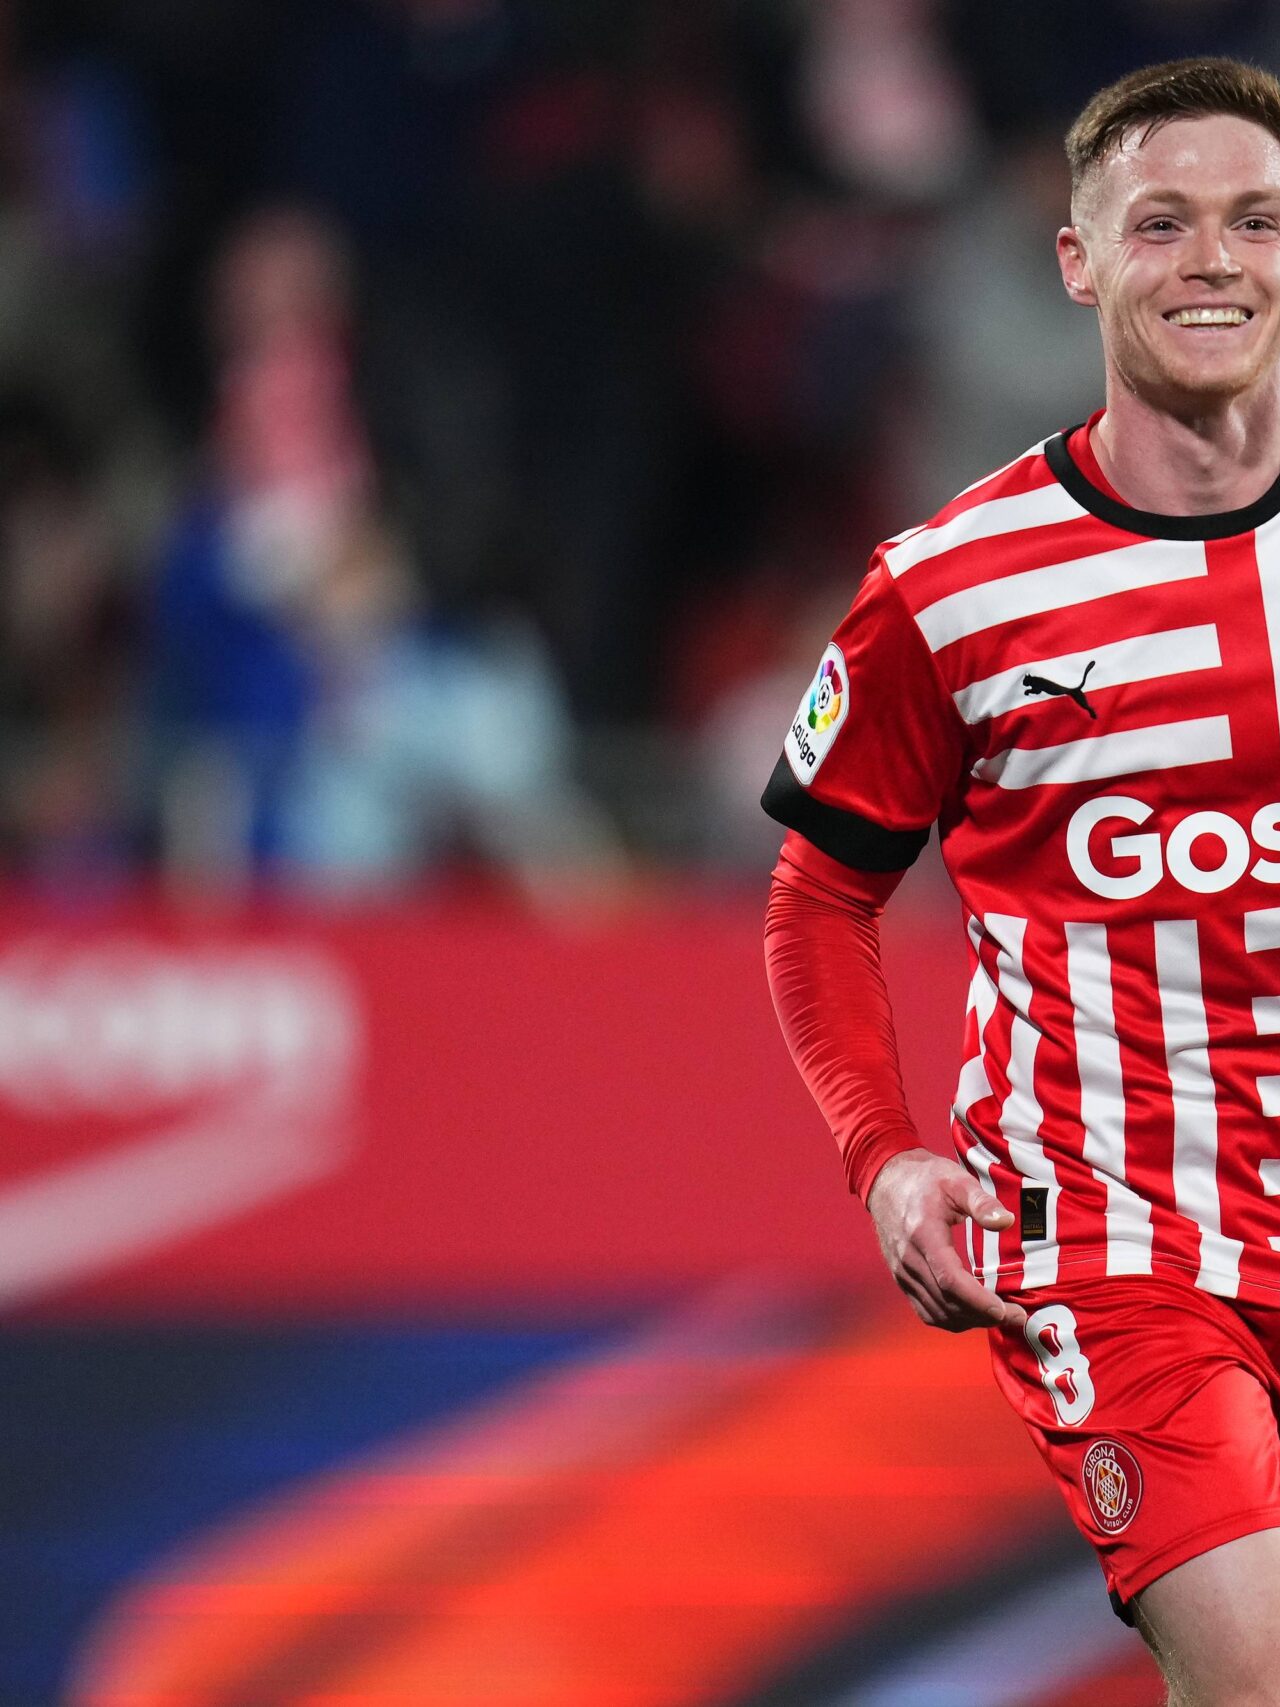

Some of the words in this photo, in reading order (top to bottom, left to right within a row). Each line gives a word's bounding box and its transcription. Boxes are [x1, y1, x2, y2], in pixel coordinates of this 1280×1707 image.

[792, 714, 817, 768] LaLiga
[1023, 1304, 1096, 1428] 8
[1085, 1446, 1116, 1478] GIRONA
[1122, 1498, 1134, 1519] CLUB
